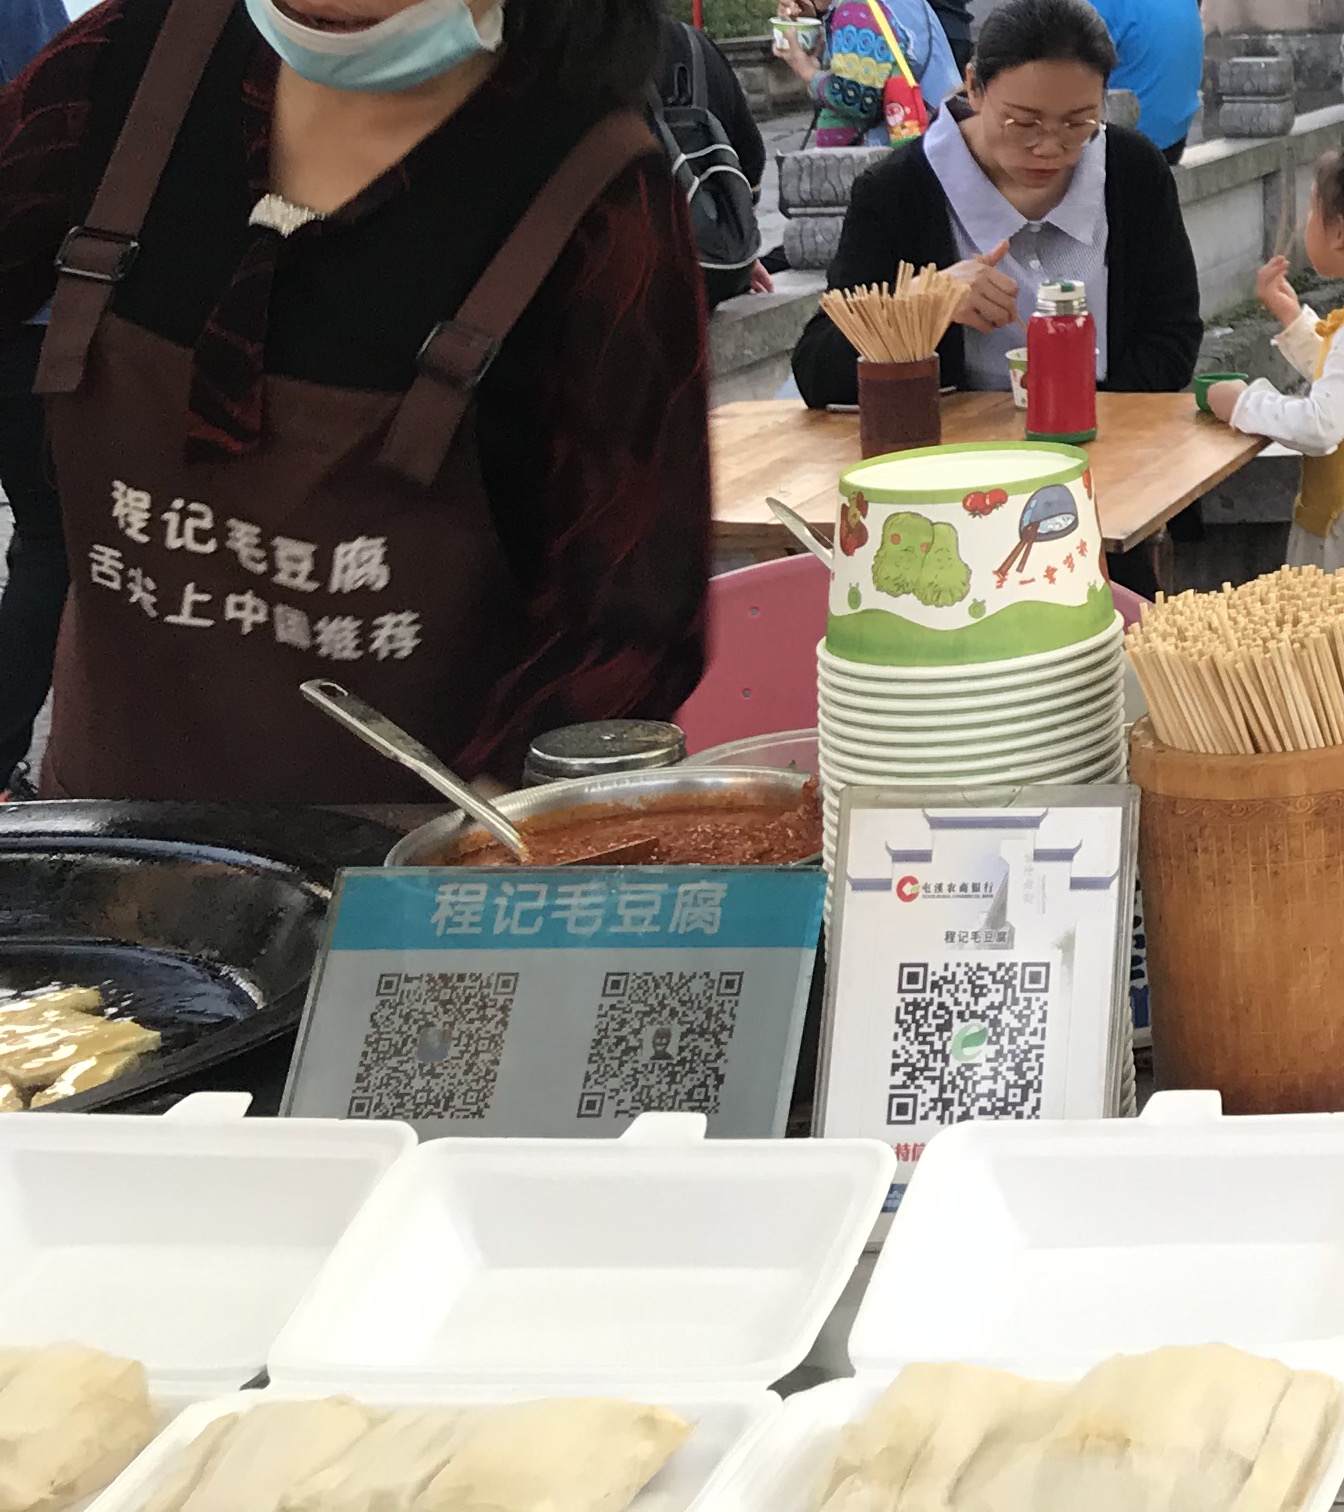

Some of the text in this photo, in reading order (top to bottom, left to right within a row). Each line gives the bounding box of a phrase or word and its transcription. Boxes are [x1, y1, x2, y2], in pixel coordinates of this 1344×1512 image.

[111, 479, 392, 595] 程记毛豆腐
[88, 543, 423, 662] 舌尖上中国推荐
[430, 881, 729, 938] 程记毛豆腐
[922, 882, 994, 894] 屯溪农商银行
[944, 930, 1009, 944] 程记毛豆腐
